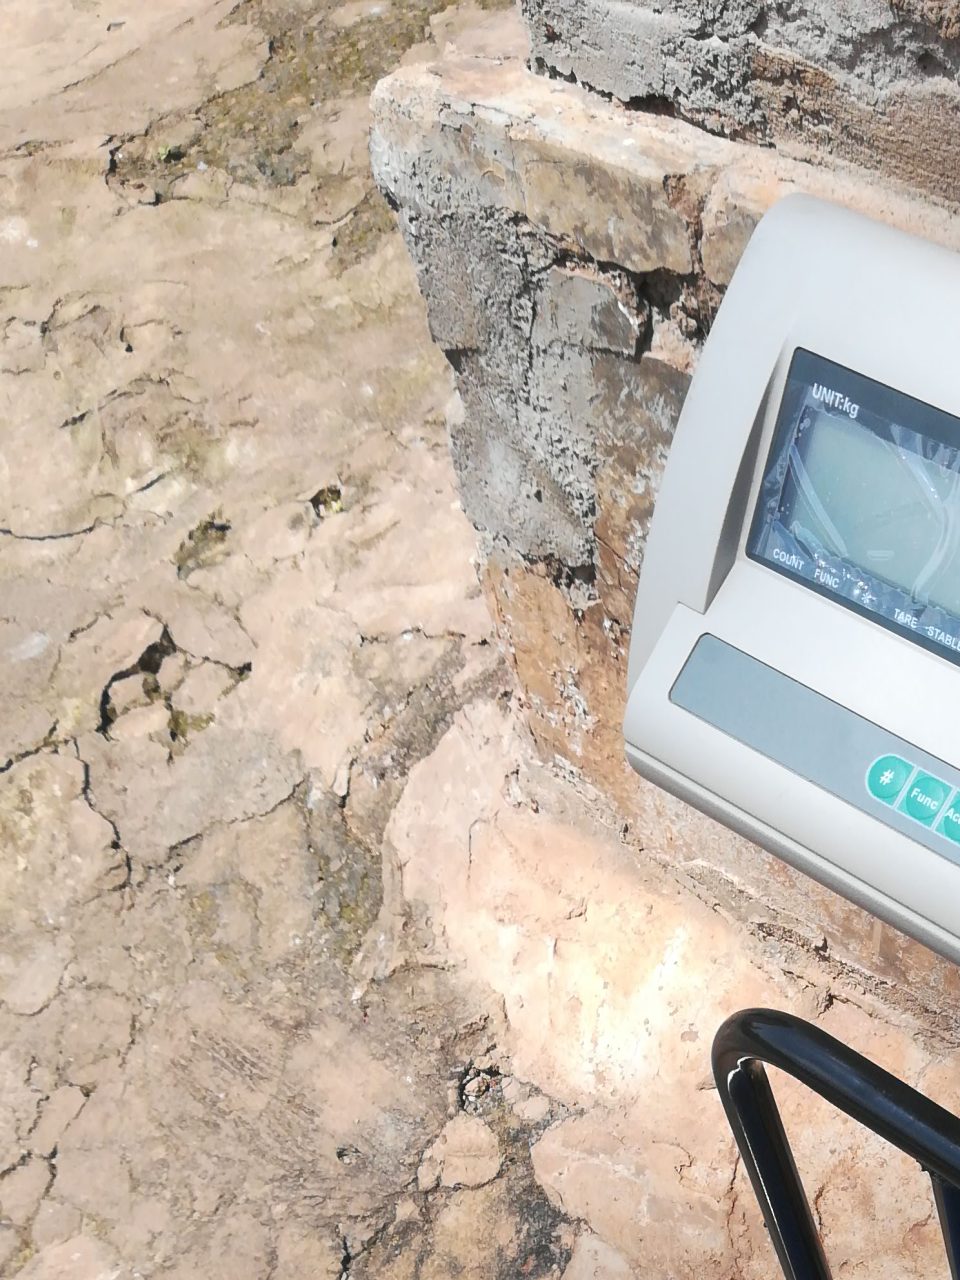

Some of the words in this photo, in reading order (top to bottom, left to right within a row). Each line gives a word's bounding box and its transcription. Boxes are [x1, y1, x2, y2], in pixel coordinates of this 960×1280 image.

[812, 382, 859, 418] UNIT:kg
[772, 548, 805, 571] COUNT
[814, 568, 840, 588] FUNC
[893, 608, 918, 628] TARE
[910, 787, 939, 811] Func
